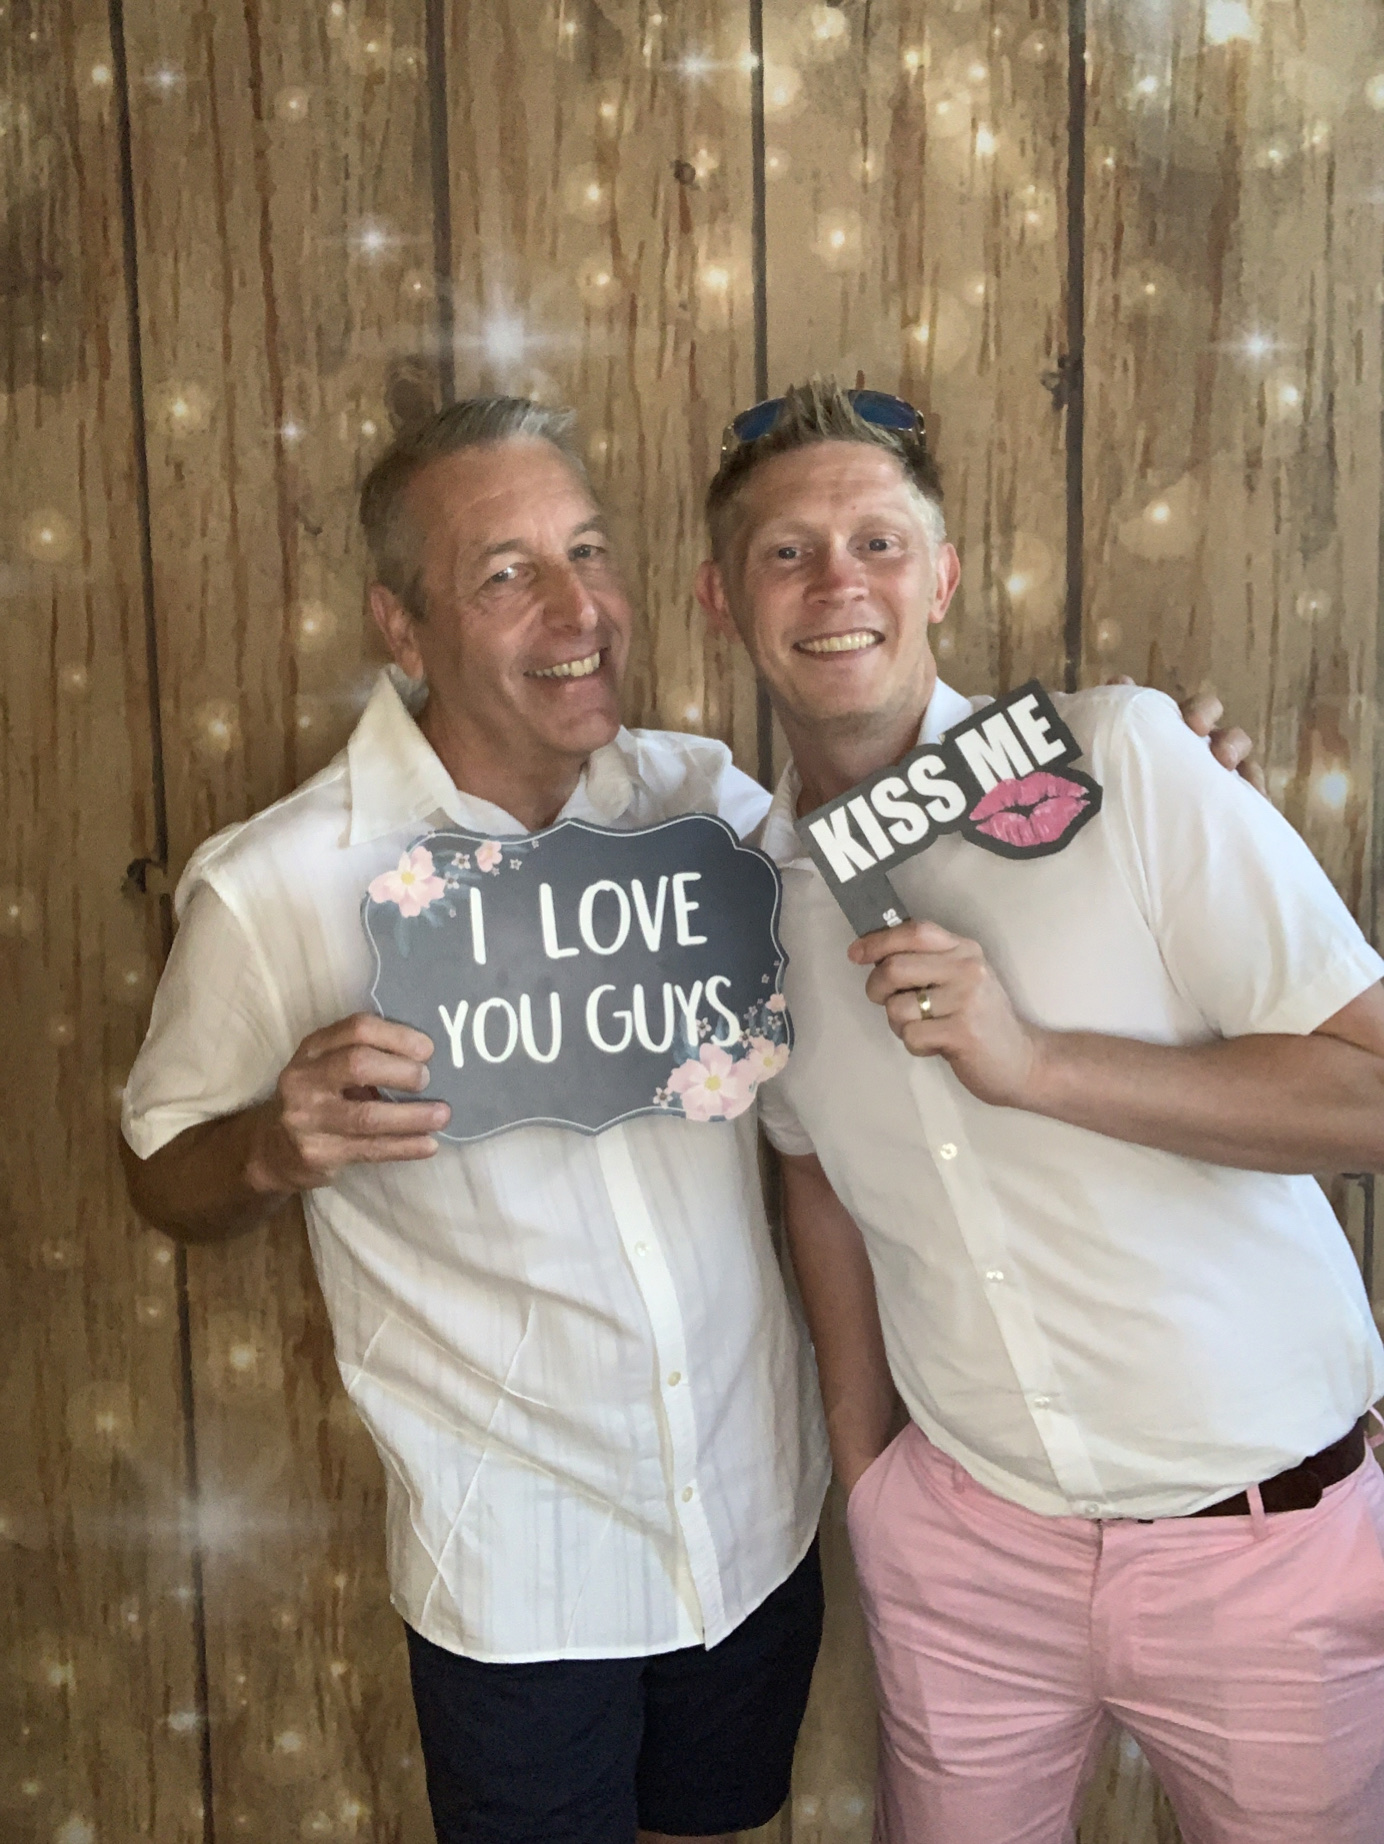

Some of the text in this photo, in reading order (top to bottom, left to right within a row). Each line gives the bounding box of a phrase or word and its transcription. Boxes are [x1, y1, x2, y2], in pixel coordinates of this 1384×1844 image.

[808, 693, 1067, 883] KISS ME
[470, 872, 707, 965] I LOVE
[438, 975, 742, 1068] YOU GUYS
